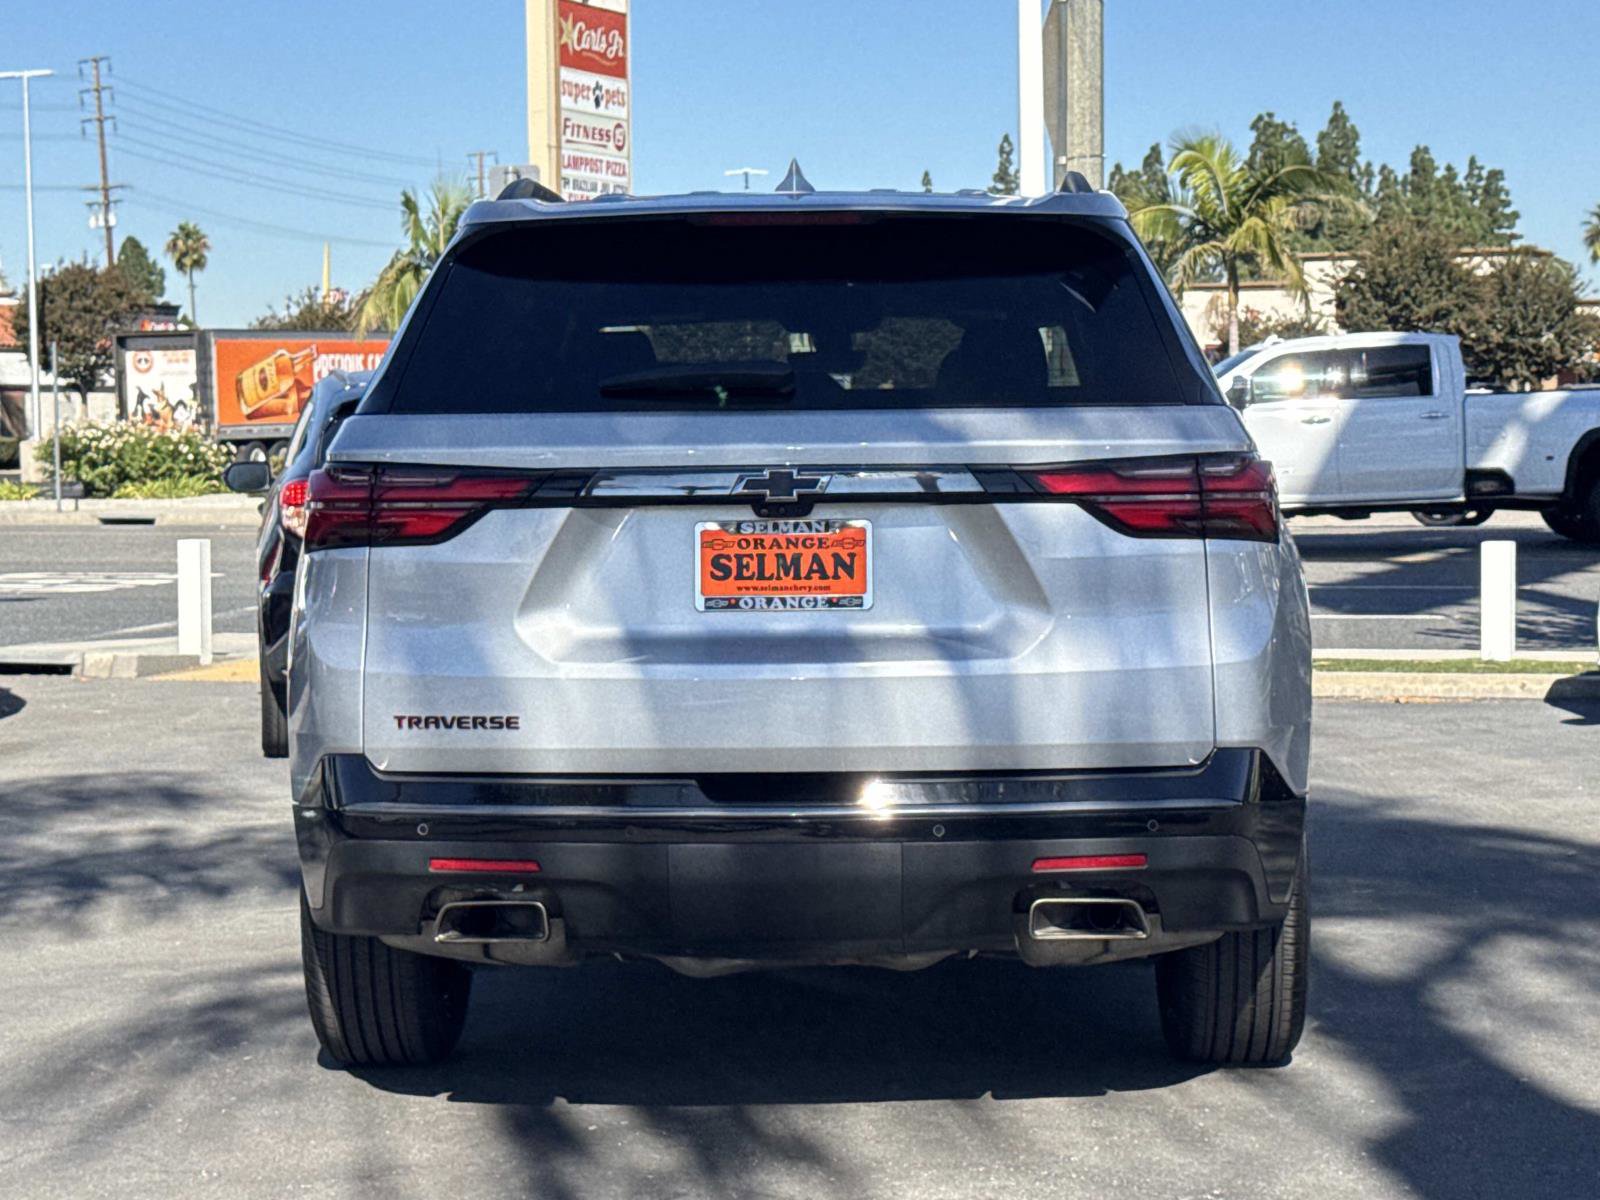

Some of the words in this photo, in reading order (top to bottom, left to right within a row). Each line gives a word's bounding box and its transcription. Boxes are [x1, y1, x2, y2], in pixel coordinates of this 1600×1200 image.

[561, 80, 591, 104] super
[604, 87, 626, 109] pets
[563, 117, 612, 142] FITNESS
[561, 154, 604, 174] LAMPPOST
[605, 160, 627, 177] PIZZA
[739, 521, 826, 534] SELMAN
[736, 537, 831, 550] ORANGE
[709, 552, 857, 581] SELMAN
[736, 584, 831, 593] www.selmanchevy.com
[738, 597, 829, 609] ORANGE
[393, 715, 520, 730] TRAVERSE
